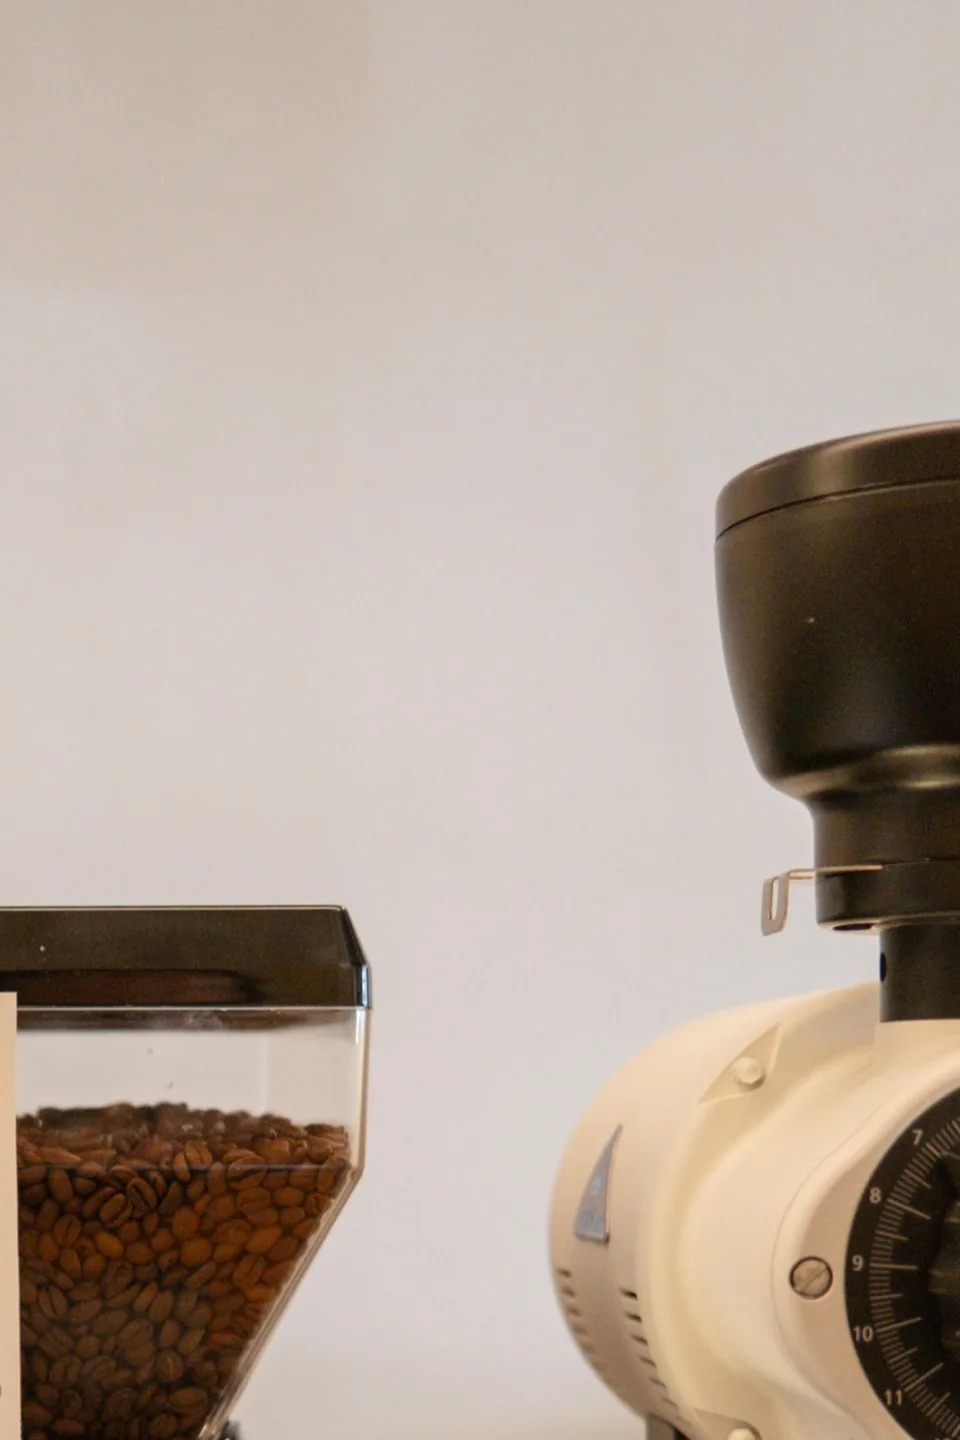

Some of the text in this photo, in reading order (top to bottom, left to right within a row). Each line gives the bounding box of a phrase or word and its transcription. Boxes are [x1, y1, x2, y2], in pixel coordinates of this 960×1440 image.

[912, 1129, 923, 1146] 7
[869, 1187, 881, 1204] 8
[851, 1255, 864, 1271] 9
[853, 1326, 874, 1342] 10
[884, 1389, 903, 1406] 11
